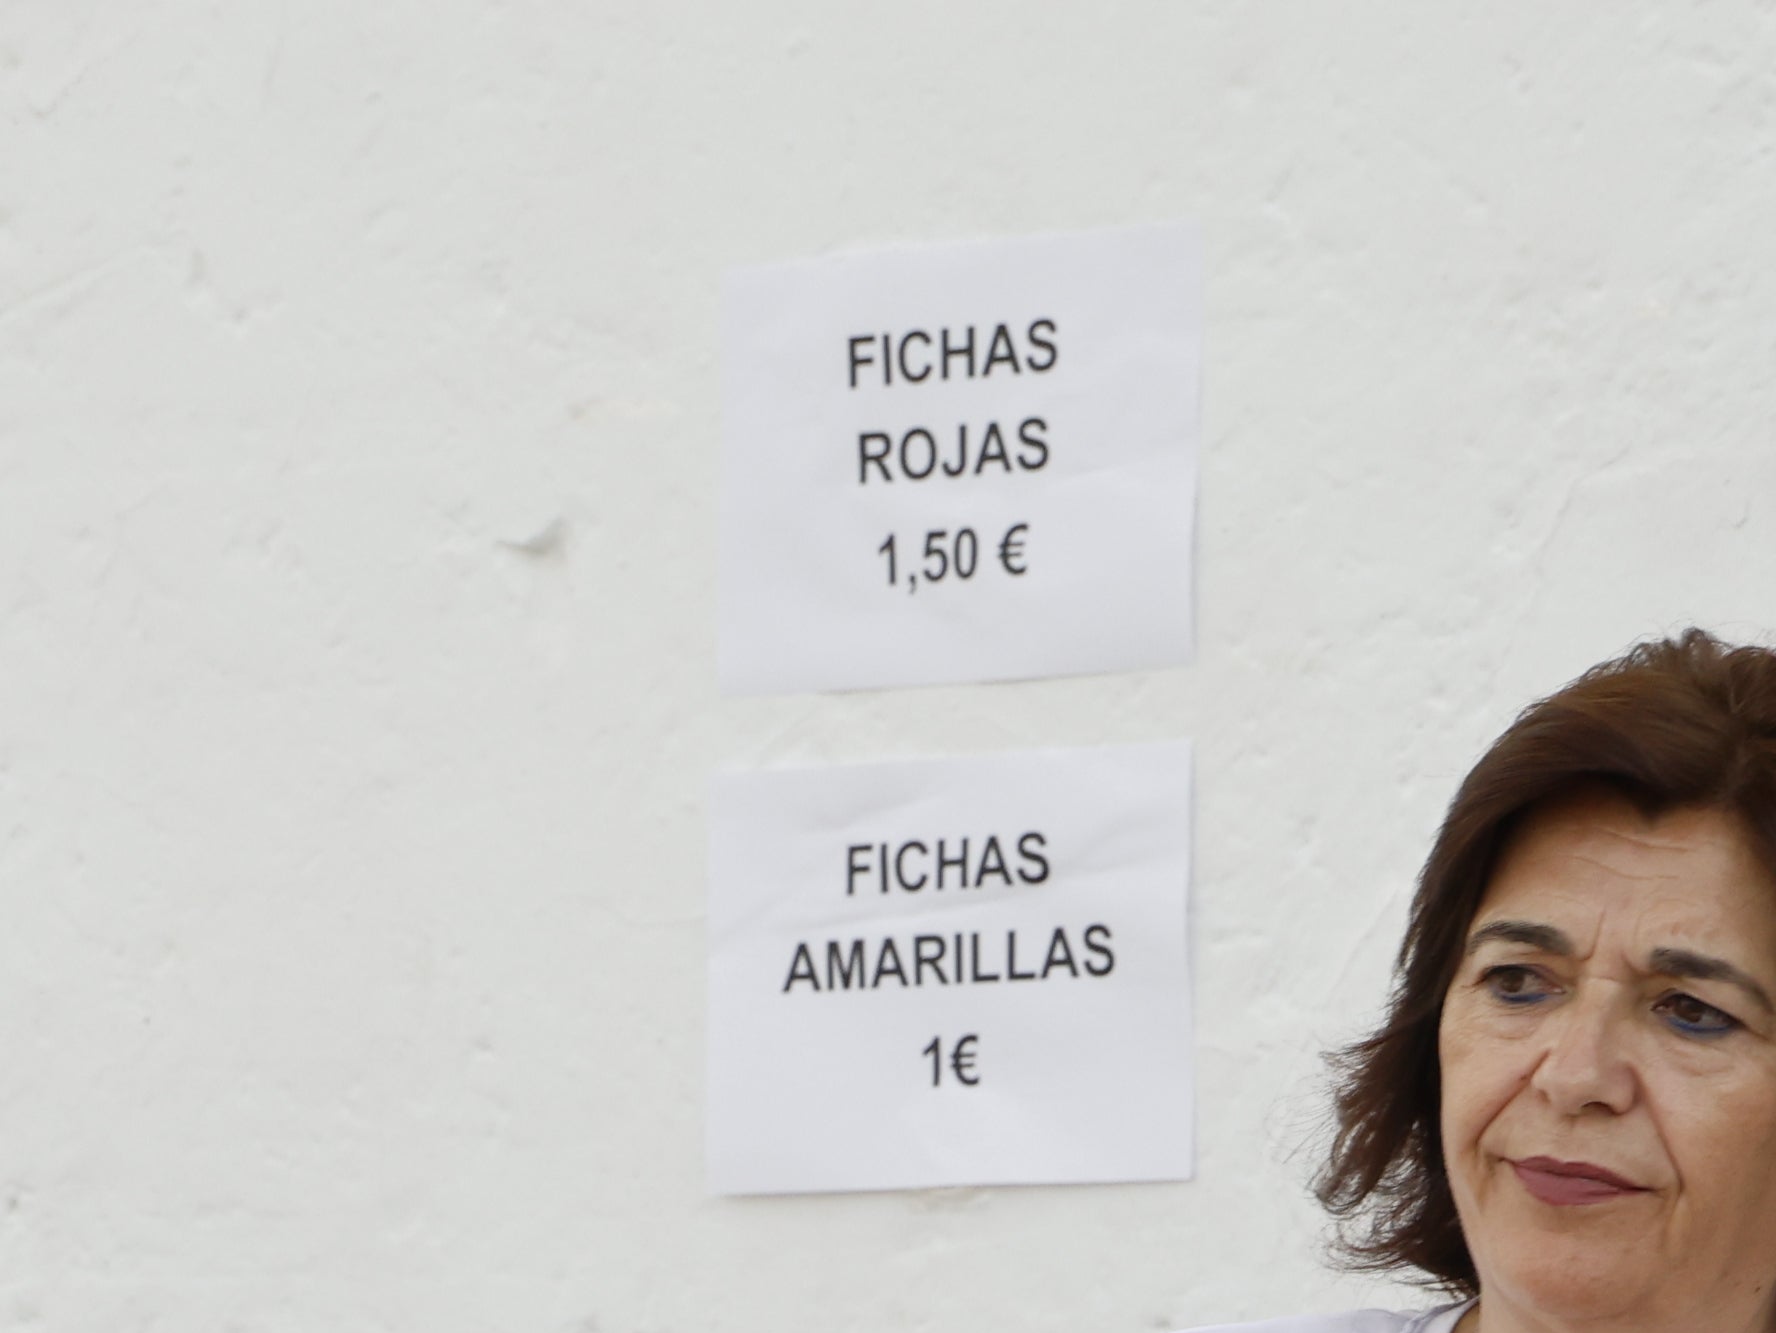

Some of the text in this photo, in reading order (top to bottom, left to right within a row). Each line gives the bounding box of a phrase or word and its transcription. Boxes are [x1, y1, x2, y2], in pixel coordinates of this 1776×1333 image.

[847, 317, 1060, 391] FICHAS
[856, 416, 1051, 485] ROJAS
[876, 522, 1031, 595] 1,50 €
[845, 830, 1052, 897] FICHAS
[781, 922, 1117, 994] AMARILLAS
[921, 1032, 982, 1089] 1€
